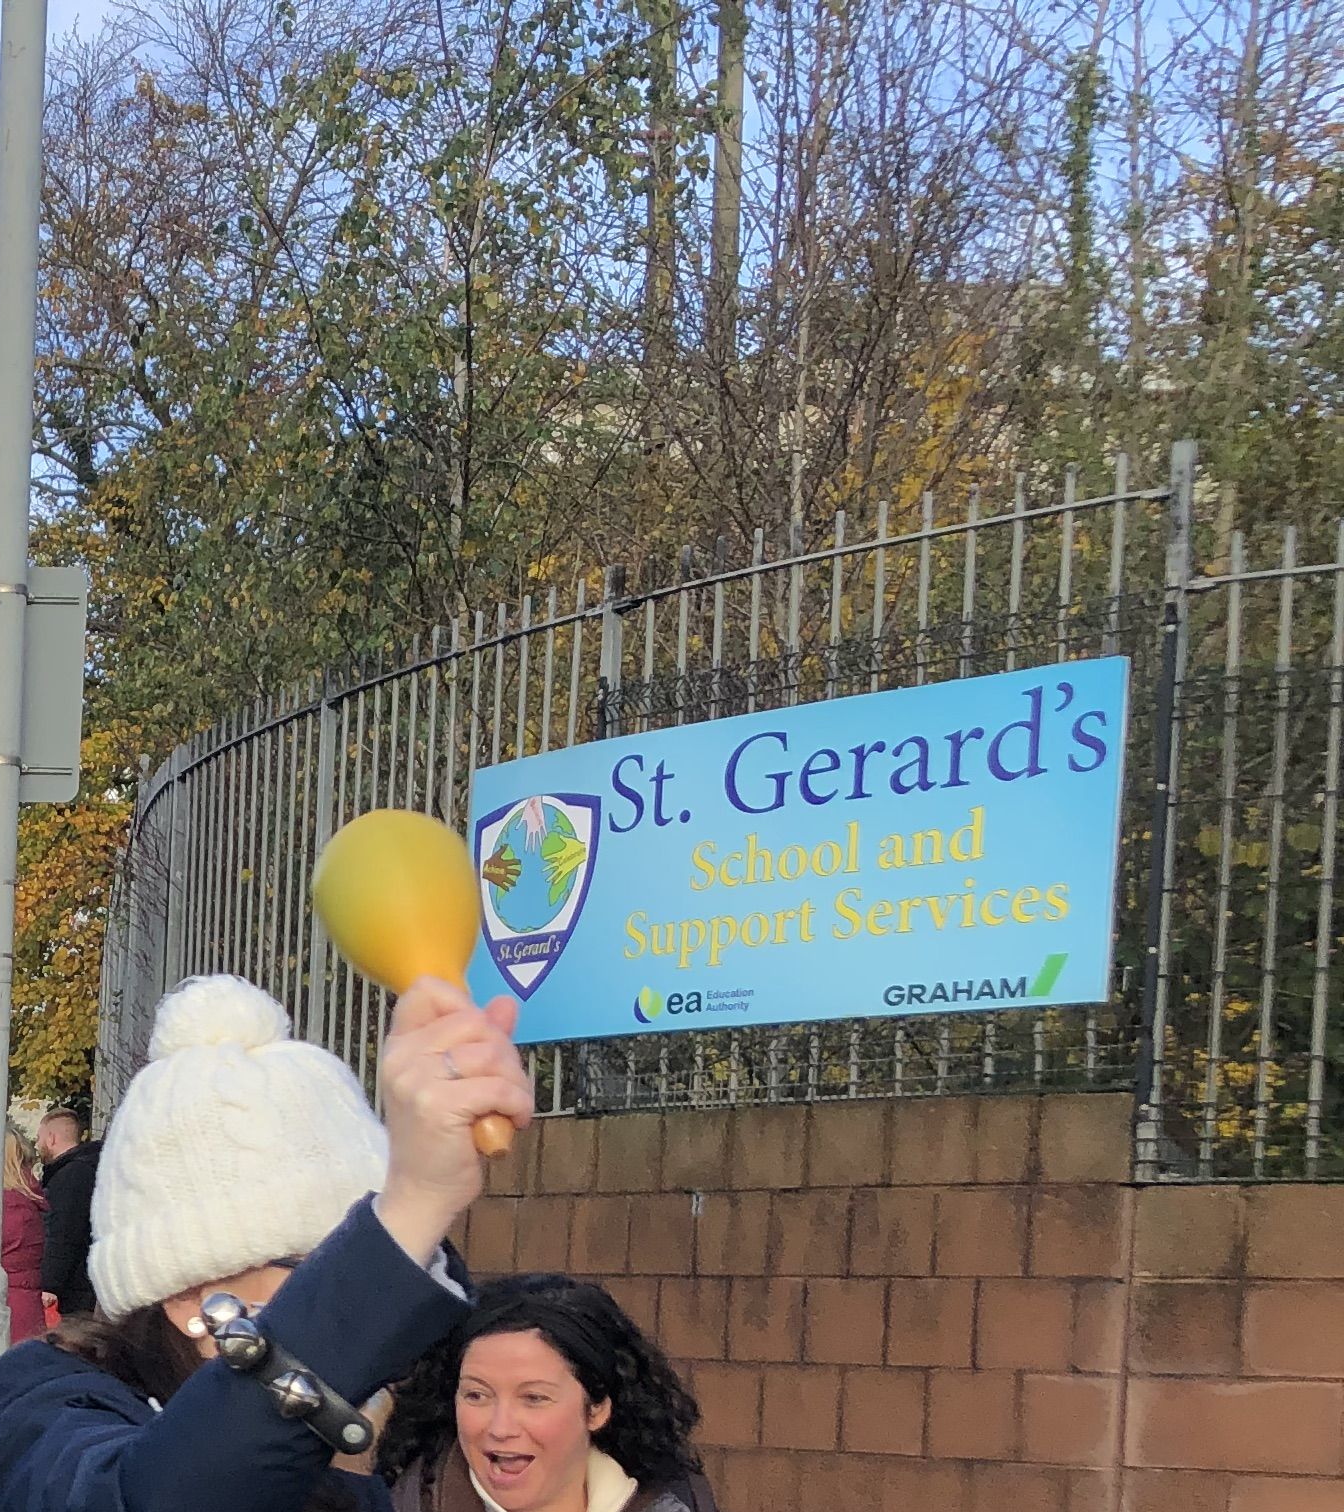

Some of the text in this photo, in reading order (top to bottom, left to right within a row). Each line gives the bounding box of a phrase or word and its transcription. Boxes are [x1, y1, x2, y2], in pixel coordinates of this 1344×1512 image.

[609, 682, 1108, 833] St. Gerard's
[689, 804, 986, 891] School and
[623, 878, 1071, 969] Support Services
[666, 990, 702, 1015] ea
[705, 1001, 749, 1012] Authority
[706, 988, 754, 1000] Education
[883, 975, 1029, 1007] GRAHAM
